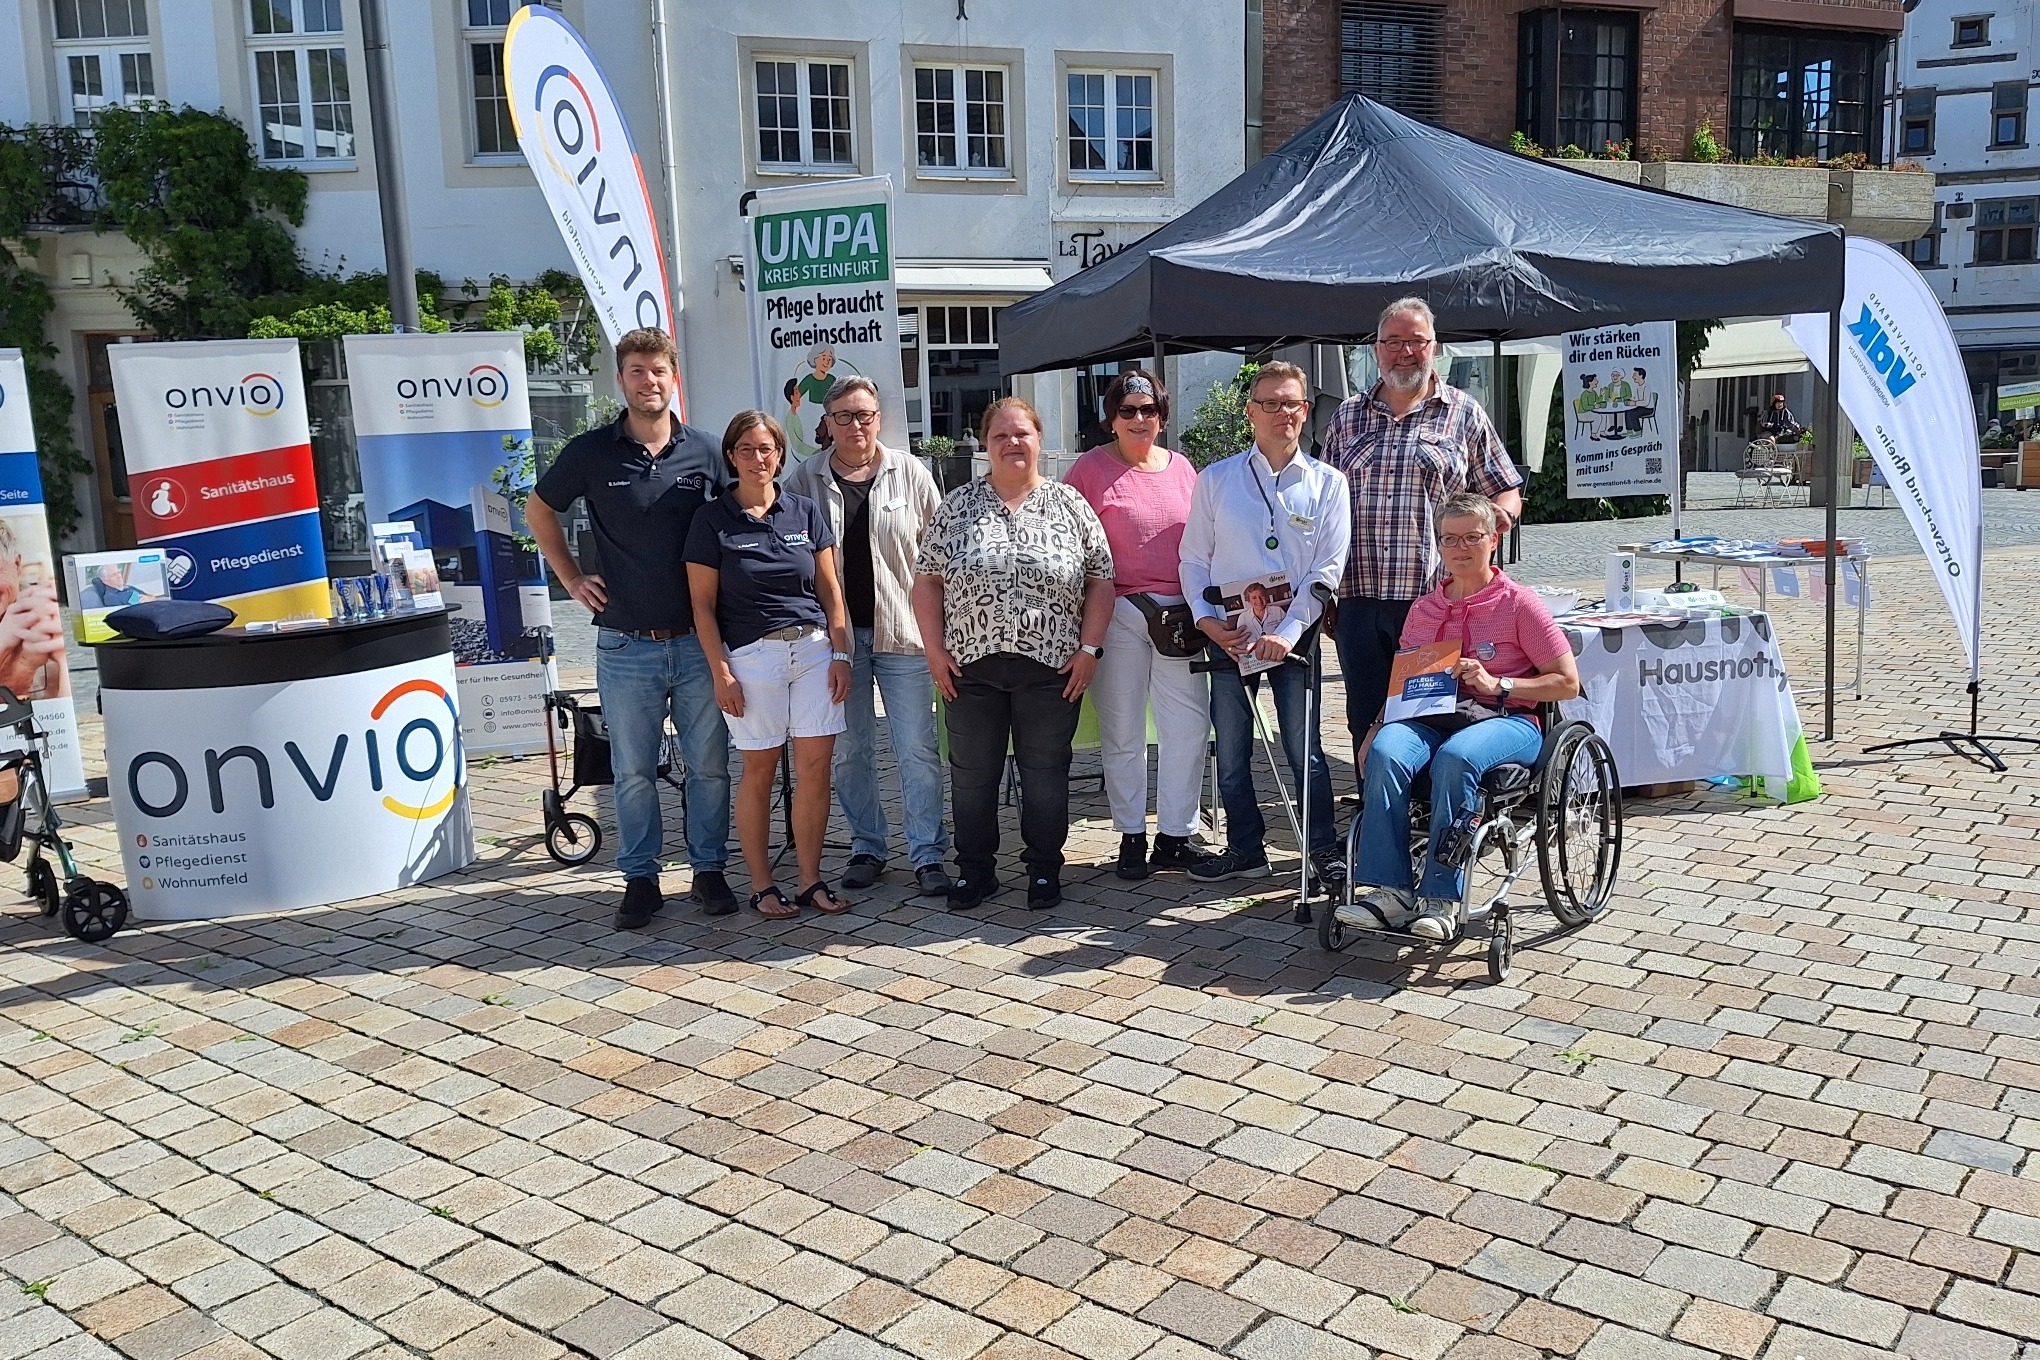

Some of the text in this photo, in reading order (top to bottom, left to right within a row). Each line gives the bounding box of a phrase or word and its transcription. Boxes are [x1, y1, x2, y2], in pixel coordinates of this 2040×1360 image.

[761, 211, 880, 264] UNPA
[1058, 241, 1078, 257] La
[764, 259, 880, 285] KREIS STEINFURT
[767, 289, 885, 323] Pflege braucht
[770, 319, 883, 350] Gemeinschaft
[1569, 330, 1641, 347] Wir stärken
[1569, 345, 1661, 363] dir den Rücken
[165, 385, 271, 409] onvio
[397, 377, 497, 399] onvio
[1575, 441, 1663, 464] Komm ins Gespräch
[1576, 461, 1614, 476] mit uns!
[0, 489, 29, 500] Seite
[200, 473, 296, 500] Sanitätshaus
[210, 543, 304, 573] Pflegedienst
[499, 695, 521, 703] 05973
[39, 712, 65, 721] 94560
[128, 718, 444, 818] onvio
[152, 832, 247, 847] Sanitätshaus
[155, 853, 248, 870] Pflegedienst
[158, 872, 248, 889] Wohnumfeld
